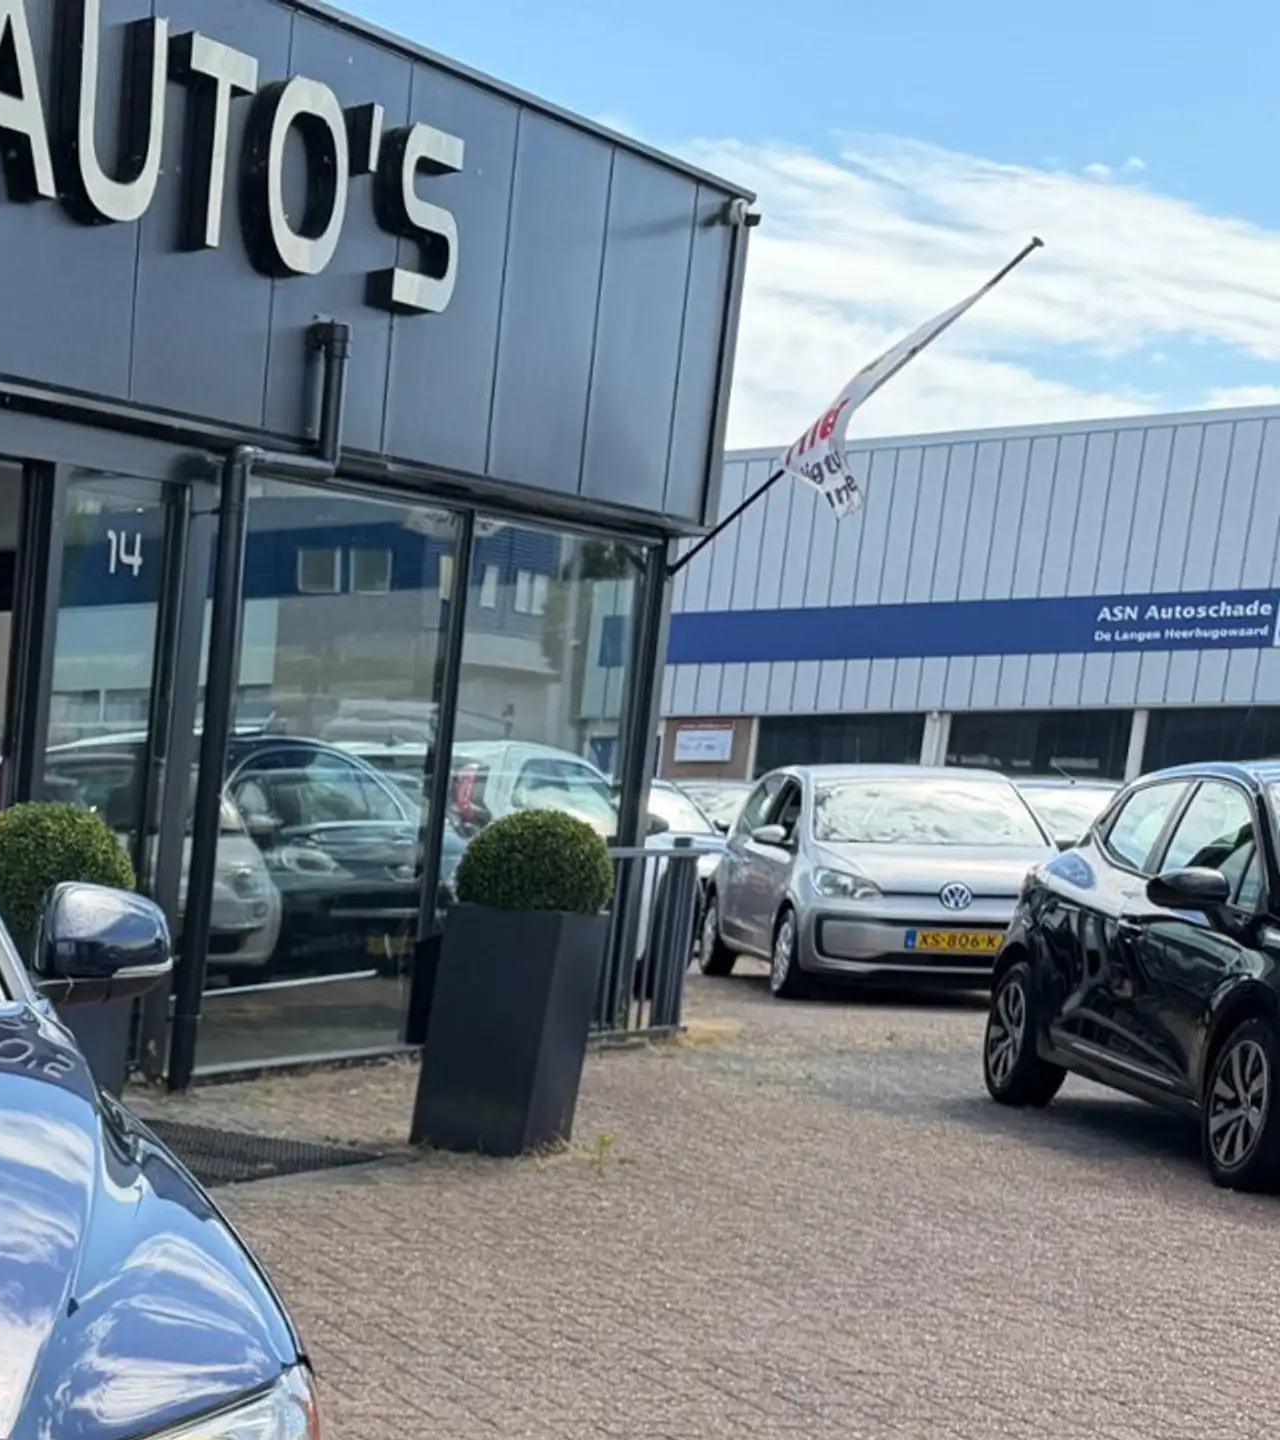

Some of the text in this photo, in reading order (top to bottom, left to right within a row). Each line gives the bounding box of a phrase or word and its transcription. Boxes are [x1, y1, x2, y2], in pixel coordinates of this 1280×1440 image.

[107, 529, 143, 577] 14
[1097, 600, 1272, 622] ASN Autoschade
[1094, 630, 1111, 642] De
[1164, 625, 1269, 641] Heerhugowaard
